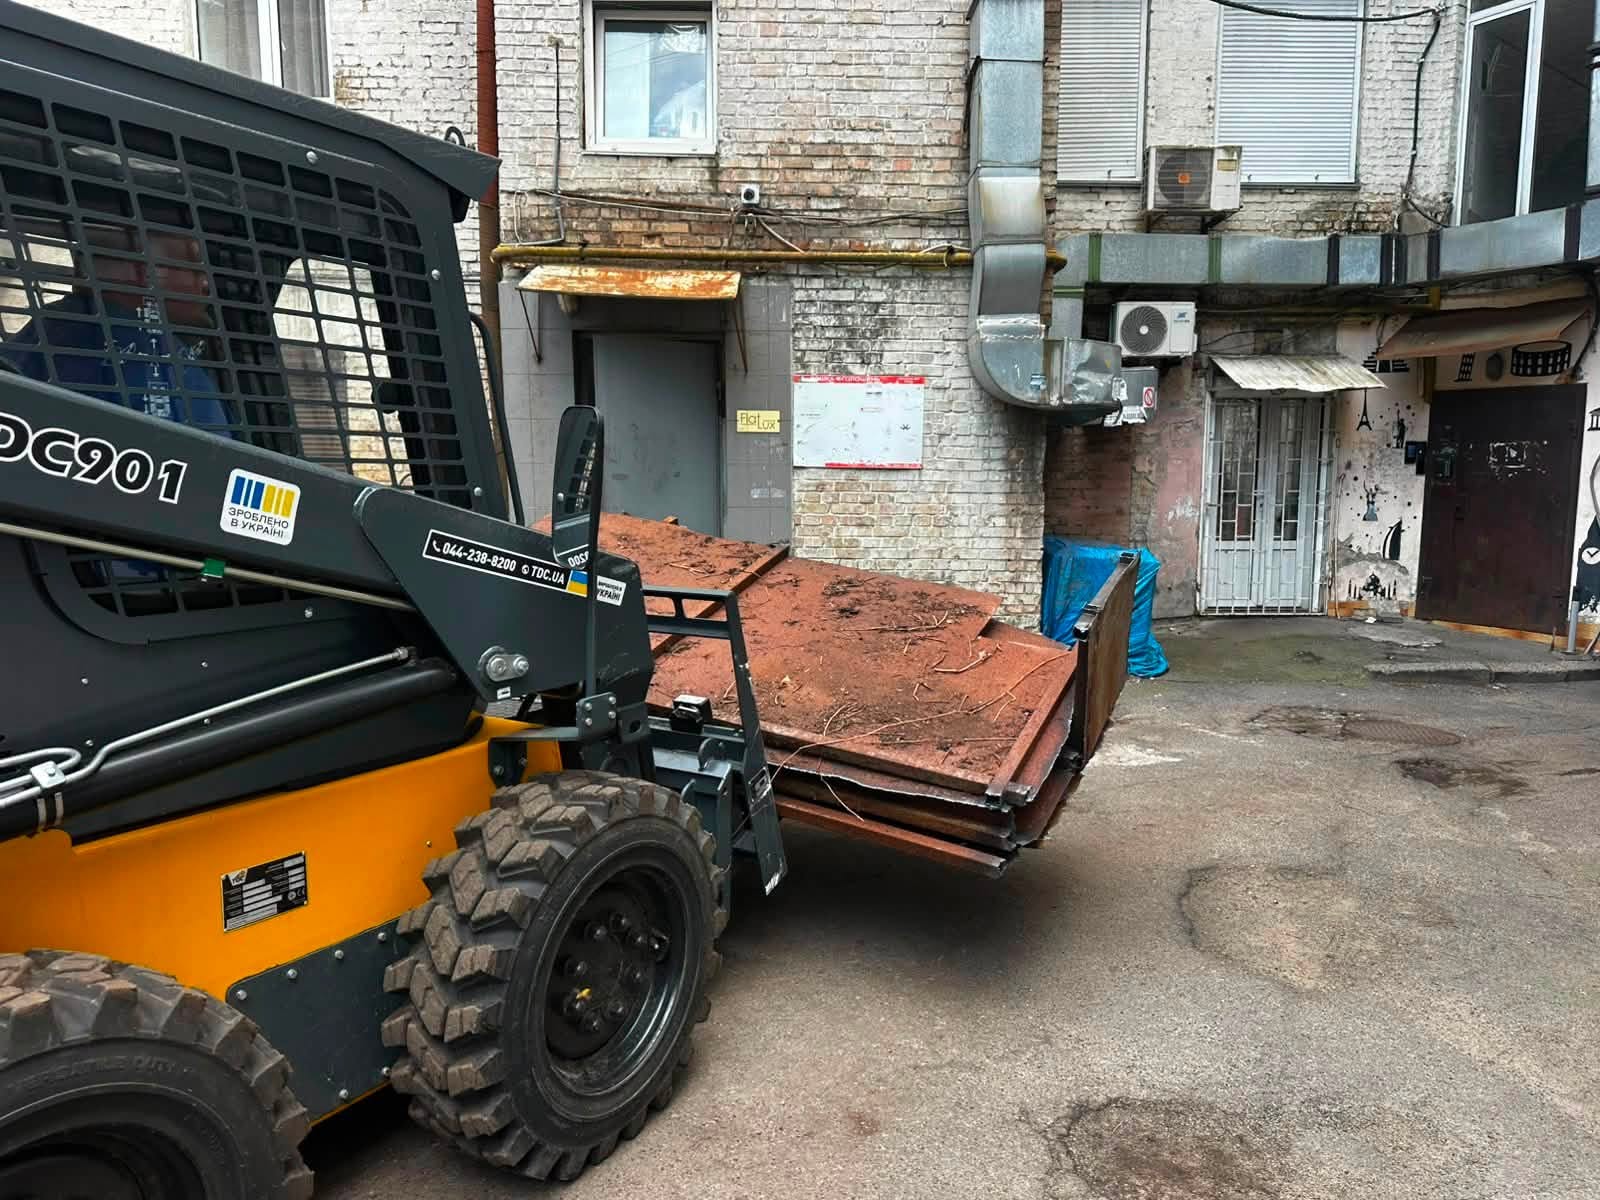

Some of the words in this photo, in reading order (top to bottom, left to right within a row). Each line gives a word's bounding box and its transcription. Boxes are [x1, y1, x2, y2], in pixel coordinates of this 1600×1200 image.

[228, 507, 289, 529] ЗРОБЛЕНО
[230, 518, 239, 527] В
[241, 521, 284, 539] УКРАЇНІ
[442, 541, 517, 572] 044-238-8200
[531, 565, 565, 585] TDC.UA
